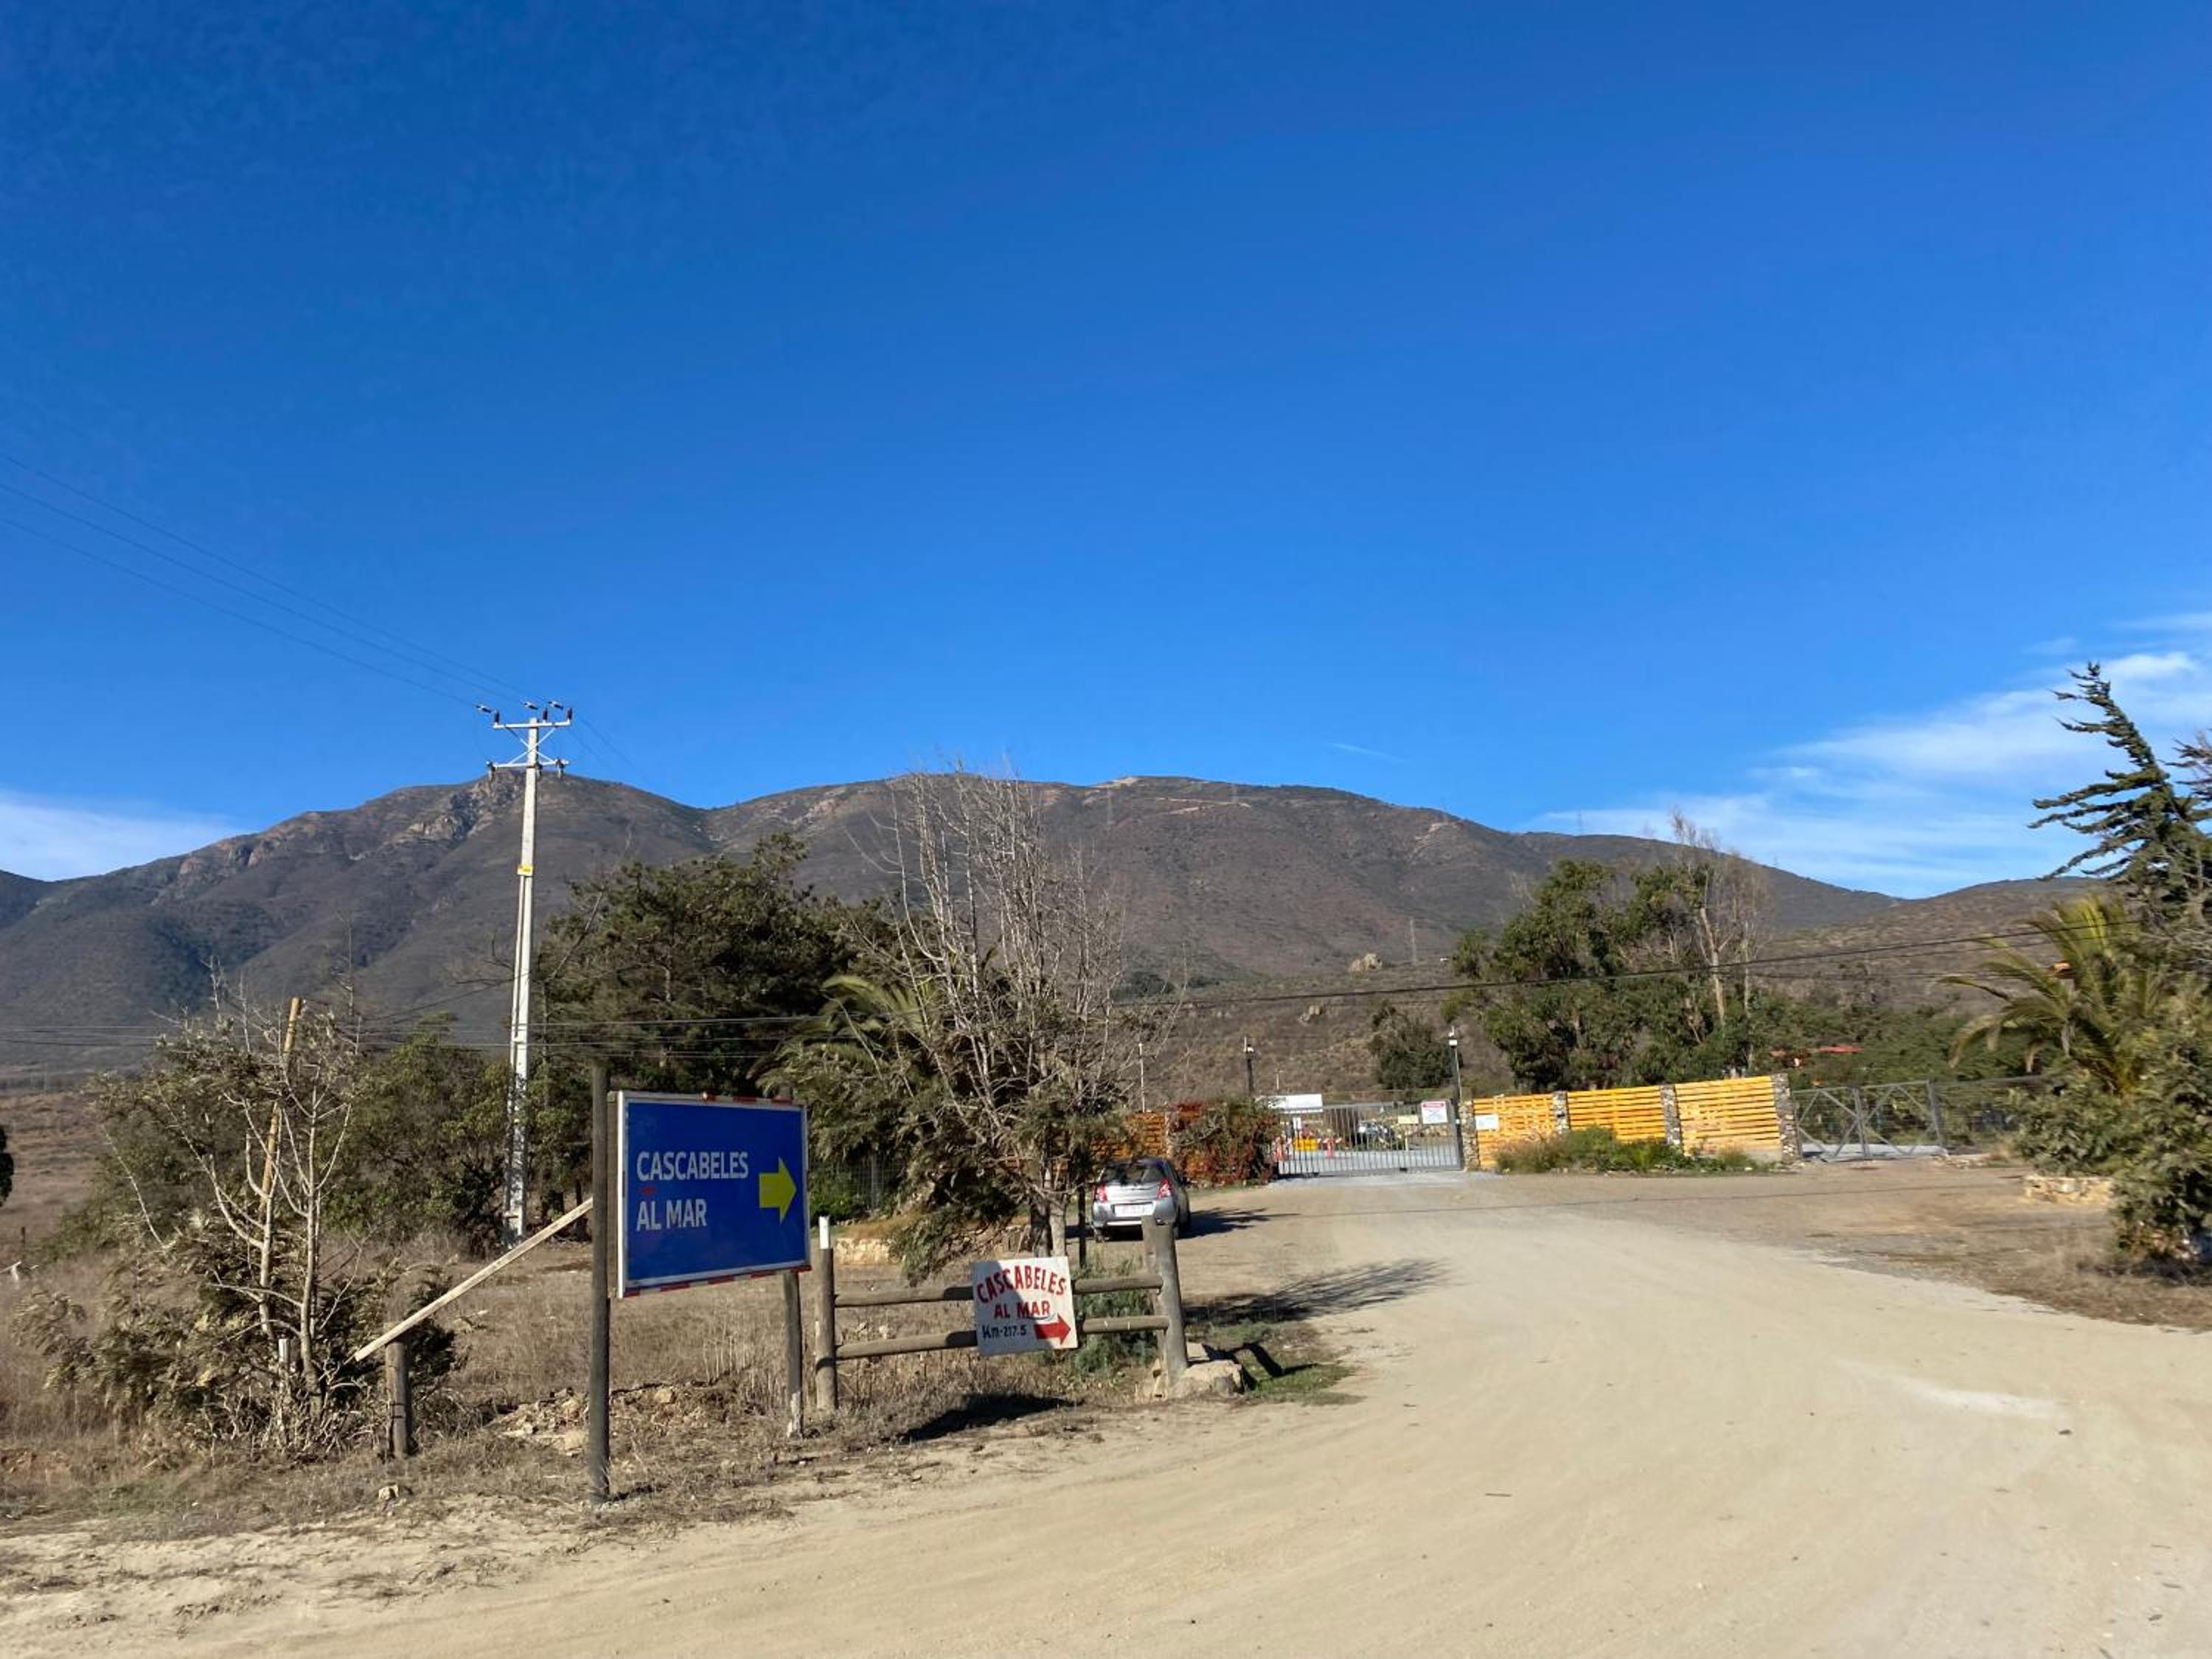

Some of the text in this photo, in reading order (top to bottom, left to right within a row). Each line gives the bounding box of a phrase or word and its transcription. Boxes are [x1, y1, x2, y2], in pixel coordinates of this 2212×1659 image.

[636, 1151, 749, 1180] CASCABELES
[636, 1199, 707, 1232] AL MAR
[977, 1265, 1066, 1303] CASCABELES
[994, 1301, 1050, 1319] AL MAR
